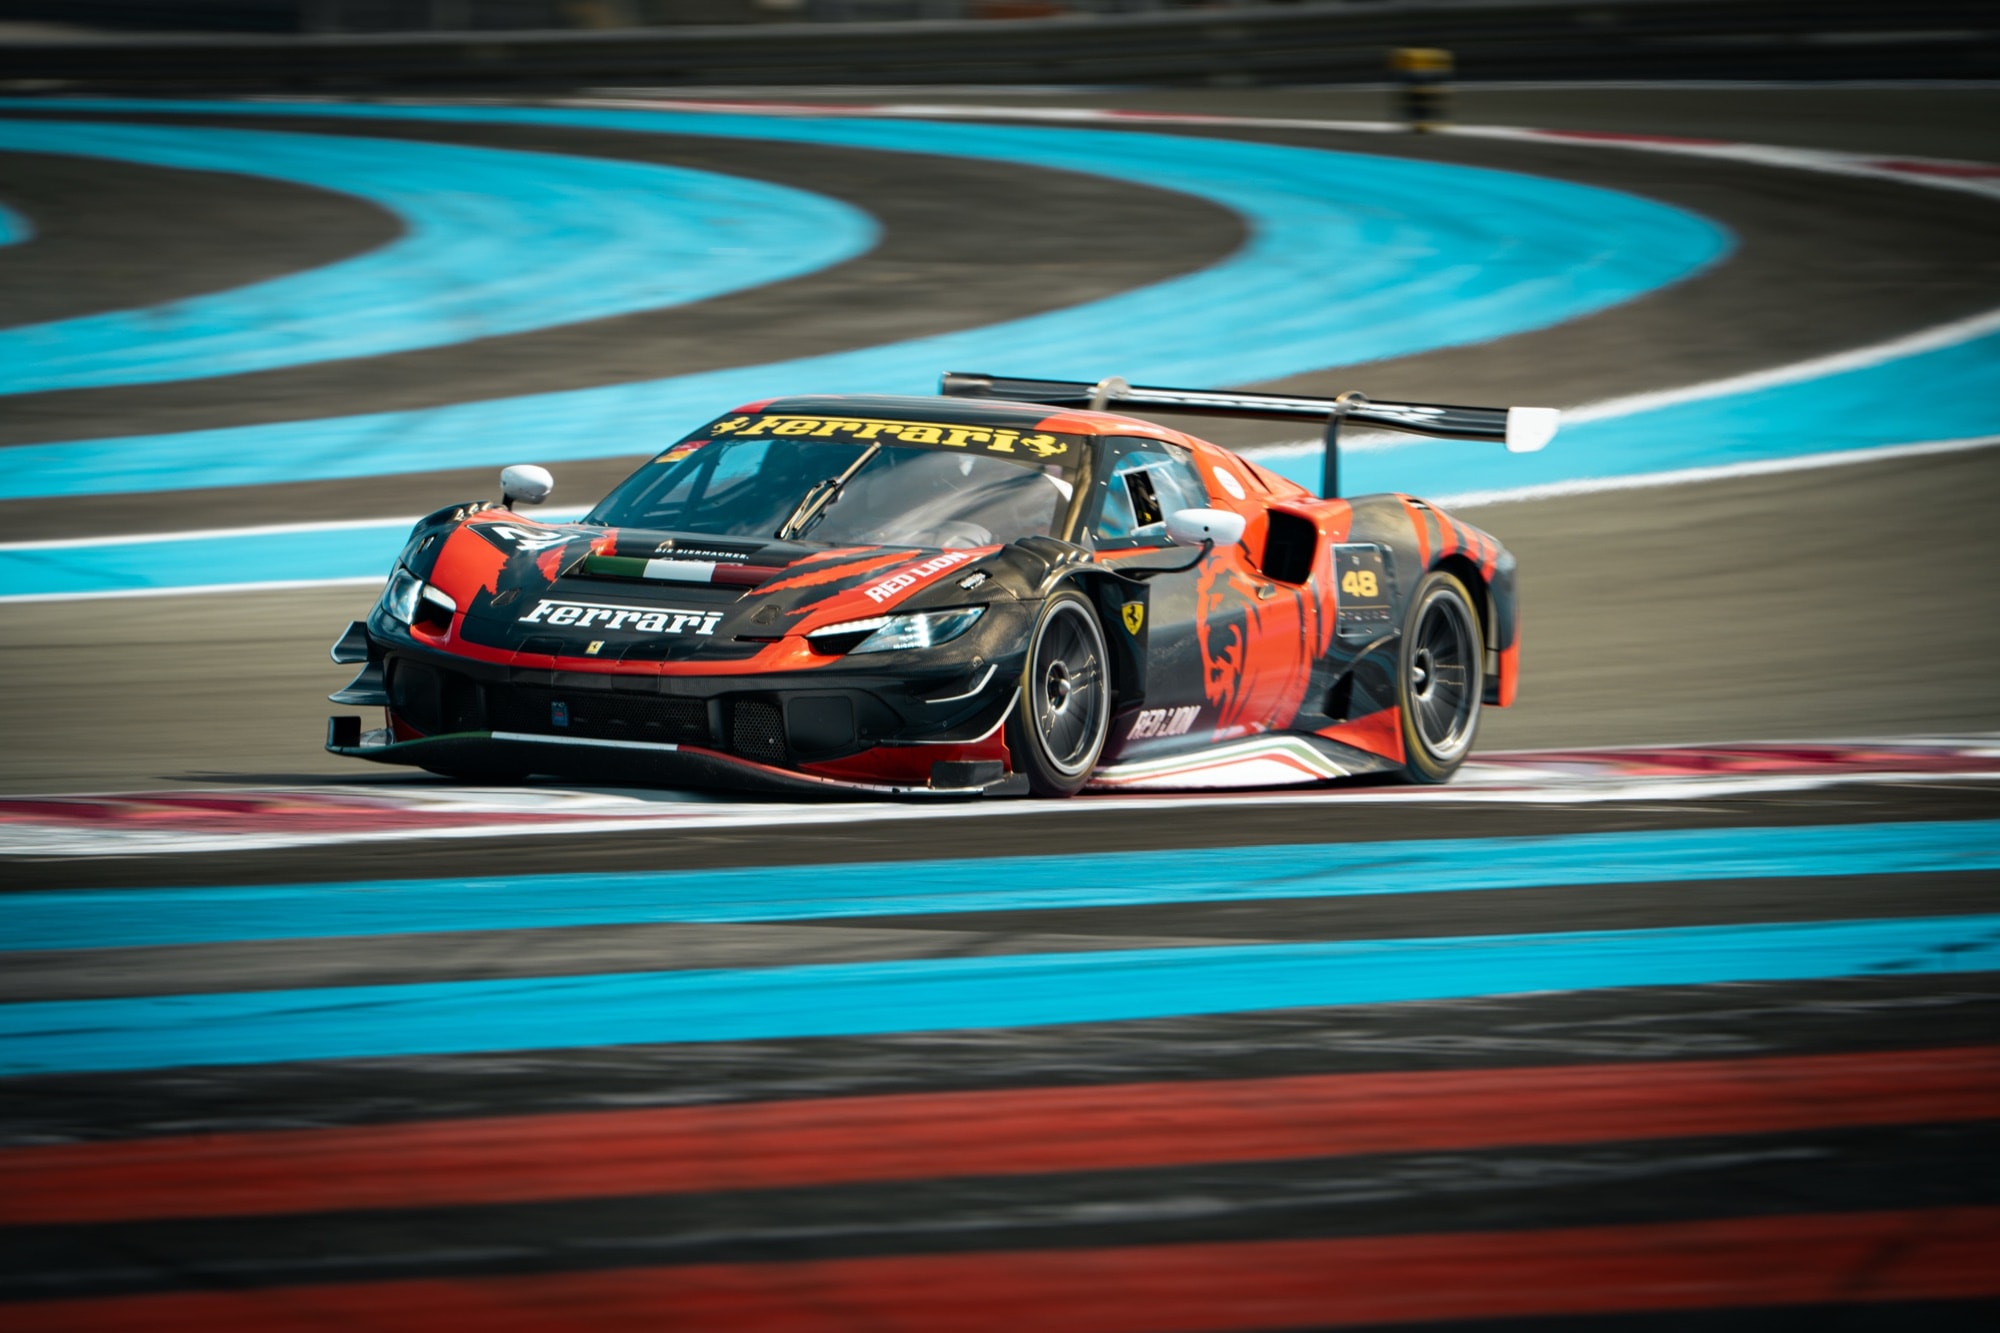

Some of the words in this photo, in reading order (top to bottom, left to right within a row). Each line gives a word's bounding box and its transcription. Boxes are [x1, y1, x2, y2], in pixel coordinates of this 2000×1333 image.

[734, 415, 1020, 453] Ferrari
[864, 573, 917, 603] RED
[910, 551, 970, 578] LION
[1341, 570, 1379, 598] 48
[518, 599, 725, 636] Ferrari
